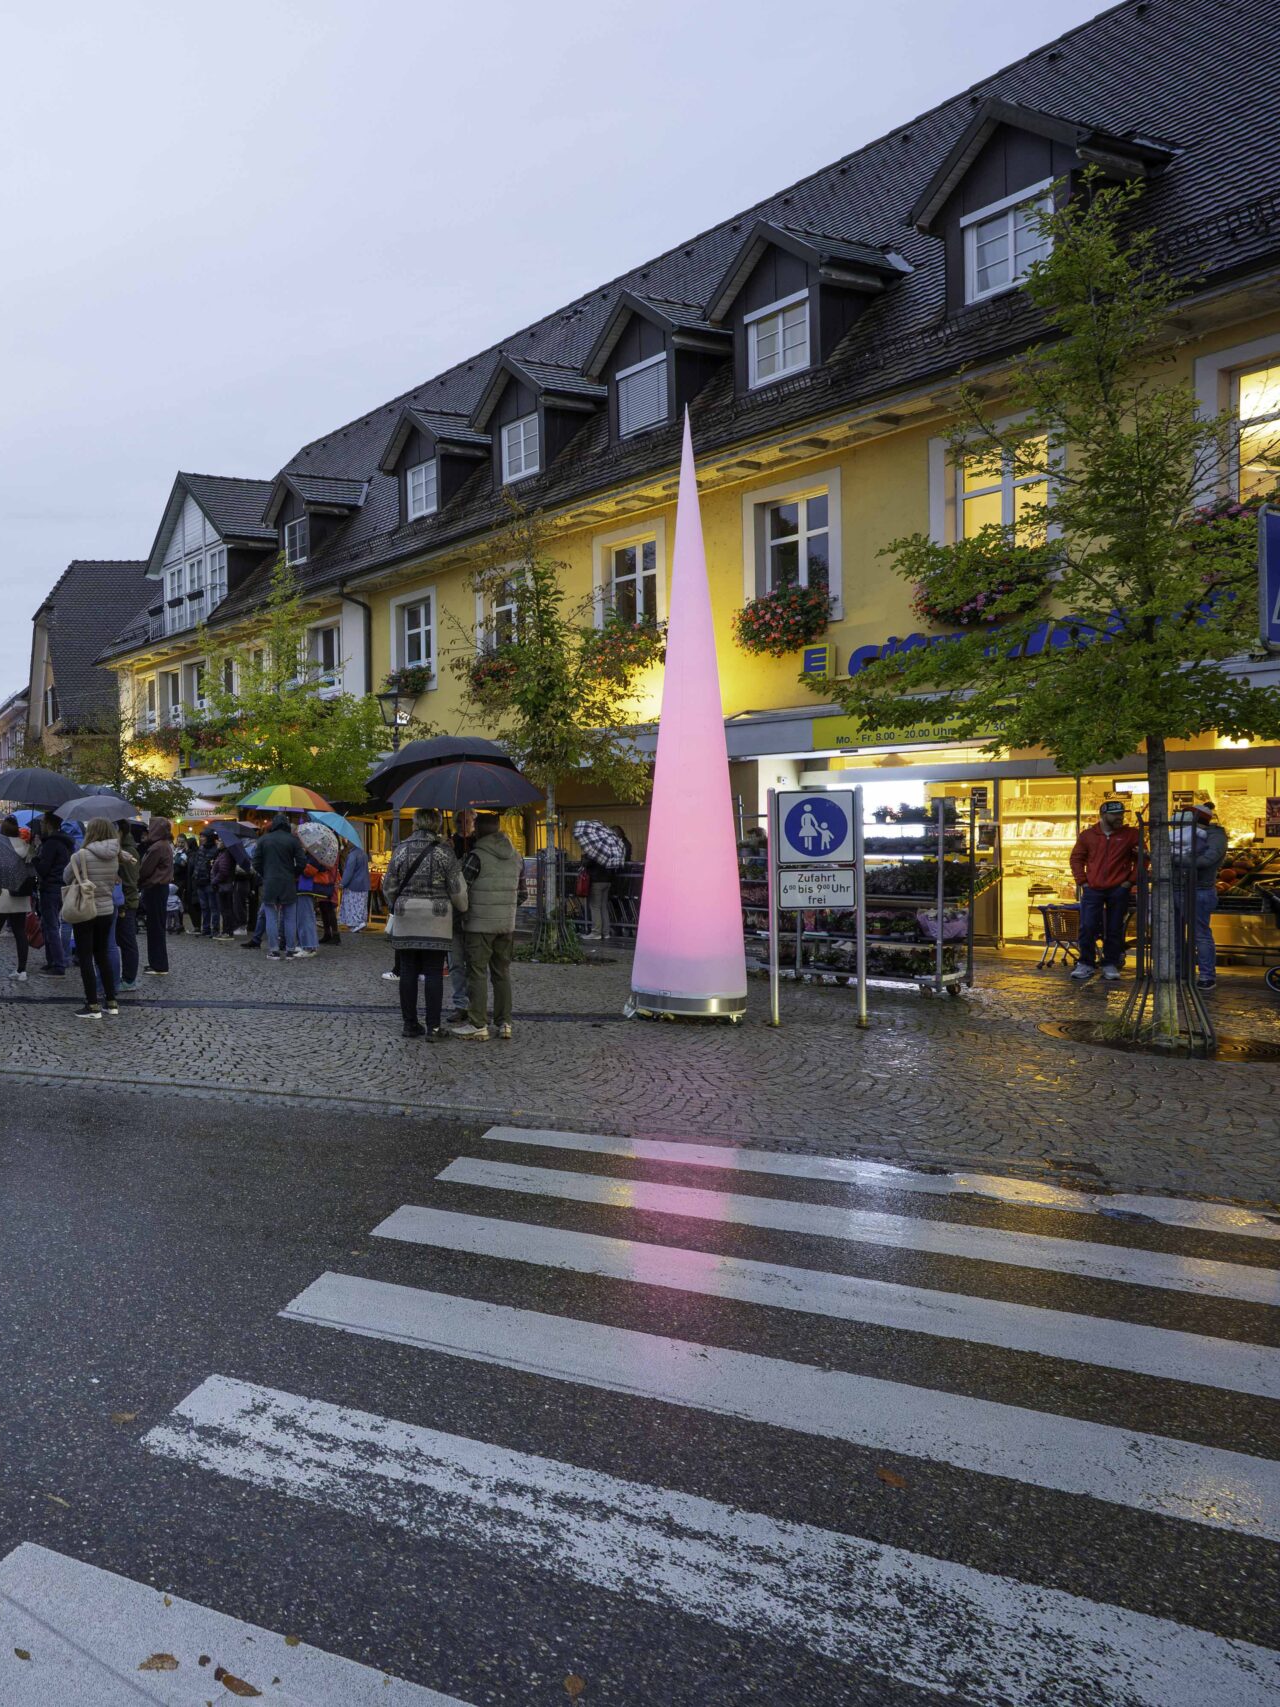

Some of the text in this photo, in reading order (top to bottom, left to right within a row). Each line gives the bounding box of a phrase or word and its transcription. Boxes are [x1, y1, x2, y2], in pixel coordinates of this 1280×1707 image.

[835, 735, 853, 745] Mo.
[861, 733, 874, 743] Fr.
[875, 730, 896, 742] 8.00
[904, 727, 930, 739] 20.00
[797, 873, 836, 883] Zufahrt
[798, 885, 814, 894] bis
[831, 883, 851, 893] Uhr
[808, 895, 827, 905] frei
